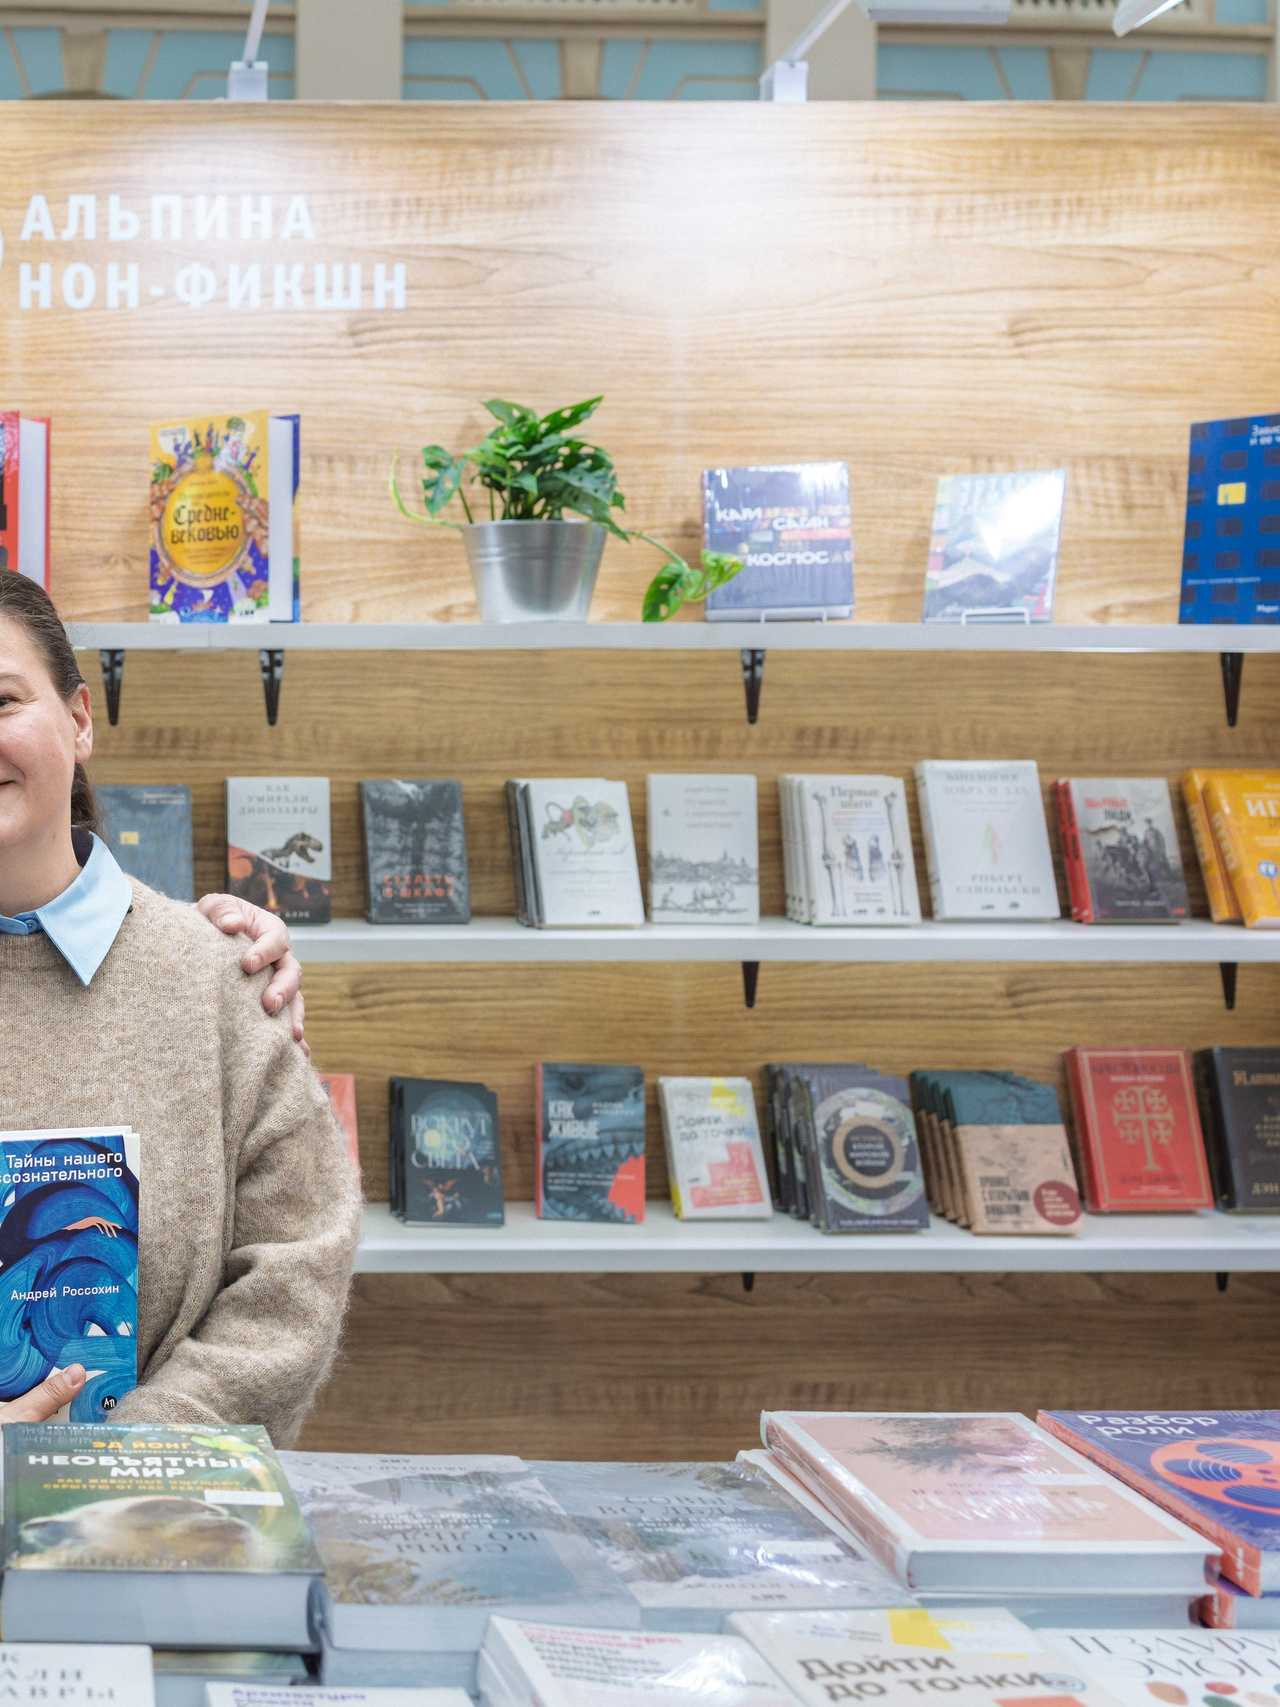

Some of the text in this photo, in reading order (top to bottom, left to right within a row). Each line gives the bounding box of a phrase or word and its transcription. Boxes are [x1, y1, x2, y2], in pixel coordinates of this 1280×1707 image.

[20, 193, 316, 241] АЛЬПИНА
[19, 261, 406, 310] НОН-ФИКШН
[173, 503, 236, 529] Средне-
[715, 507, 763, 523] КАРЛ
[771, 515, 830, 531] САГАН
[171, 524, 240, 545] вековью
[746, 550, 830, 567] КОСМОС
[247, 795, 310, 804] УМИРАЛИ
[830, 785, 880, 799] Первые
[238, 806, 319, 816] ДИНОЗАВРЫ
[383, 874, 455, 886] СКЕЛЕТЫ
[399, 887, 456, 898] ШКАФУ
[547, 1100, 576, 1119] КАК
[547, 1119, 600, 1140] ЖИВЫЕ
[6, 1151, 123, 1169] Тайны нашего
[11, 1283, 120, 1302] Андрей Россохин
[1077, 1414, 1219, 1427] Разбор
[1095, 1424, 1195, 1437] роли
[92, 1440, 192, 1450] ЭД ЙОНГ
[28, 1454, 263, 1469] НЕОБЪЯТНЫЙ
[110, 1467, 186, 1478] МИР
[169, 1479, 241, 1487] ОЩУЩАЮТ
[796, 1654, 956, 1682] Дойти
[823, 1671, 1051, 1702] до точки
